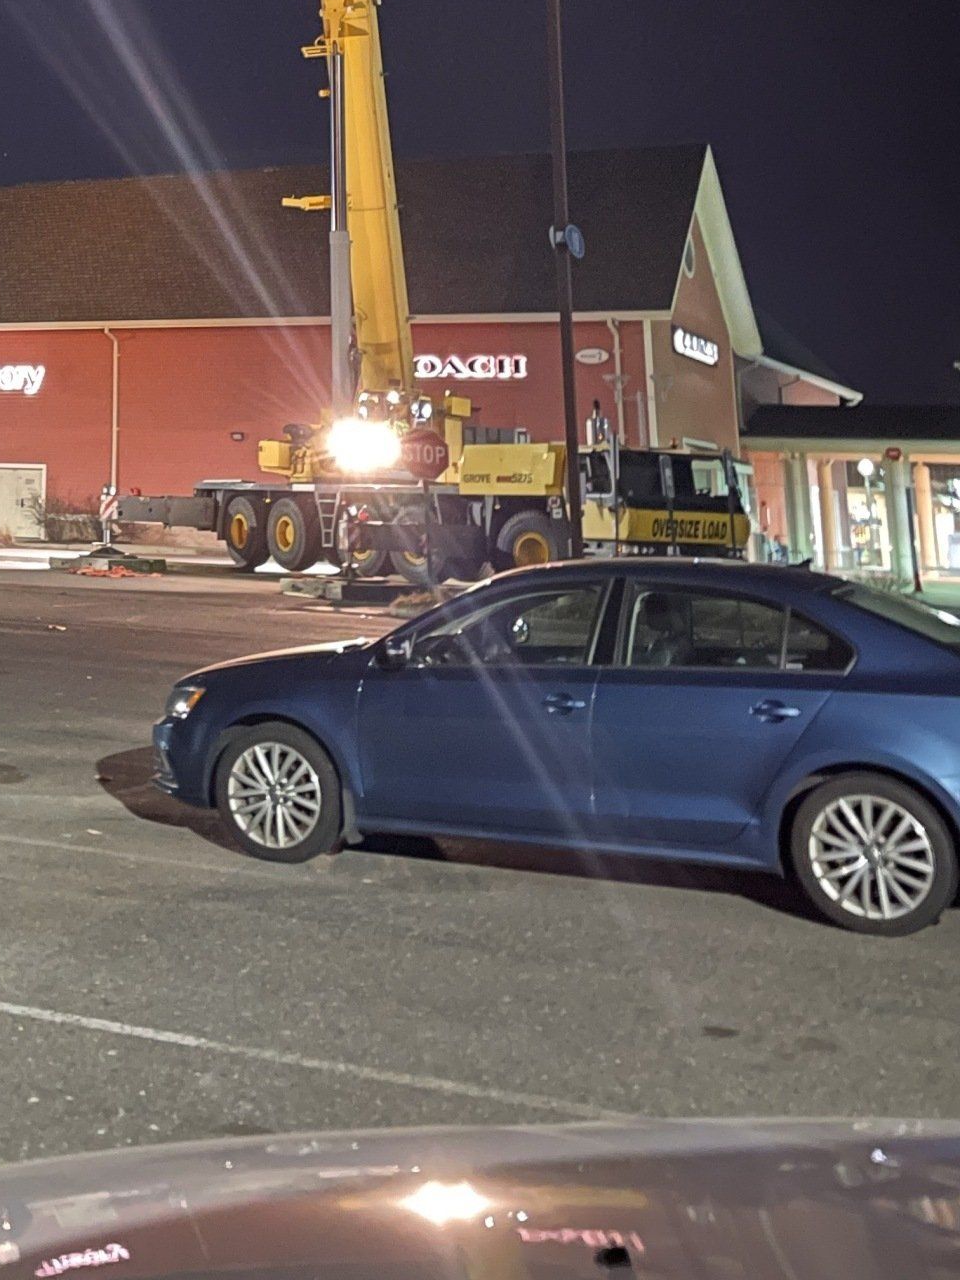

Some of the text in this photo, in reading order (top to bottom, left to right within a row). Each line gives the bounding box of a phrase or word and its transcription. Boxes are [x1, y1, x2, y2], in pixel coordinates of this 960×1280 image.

[412, 355, 528, 378] OACH
[403, 443, 445, 464] STOP
[702, 519, 728, 539] LOAD
